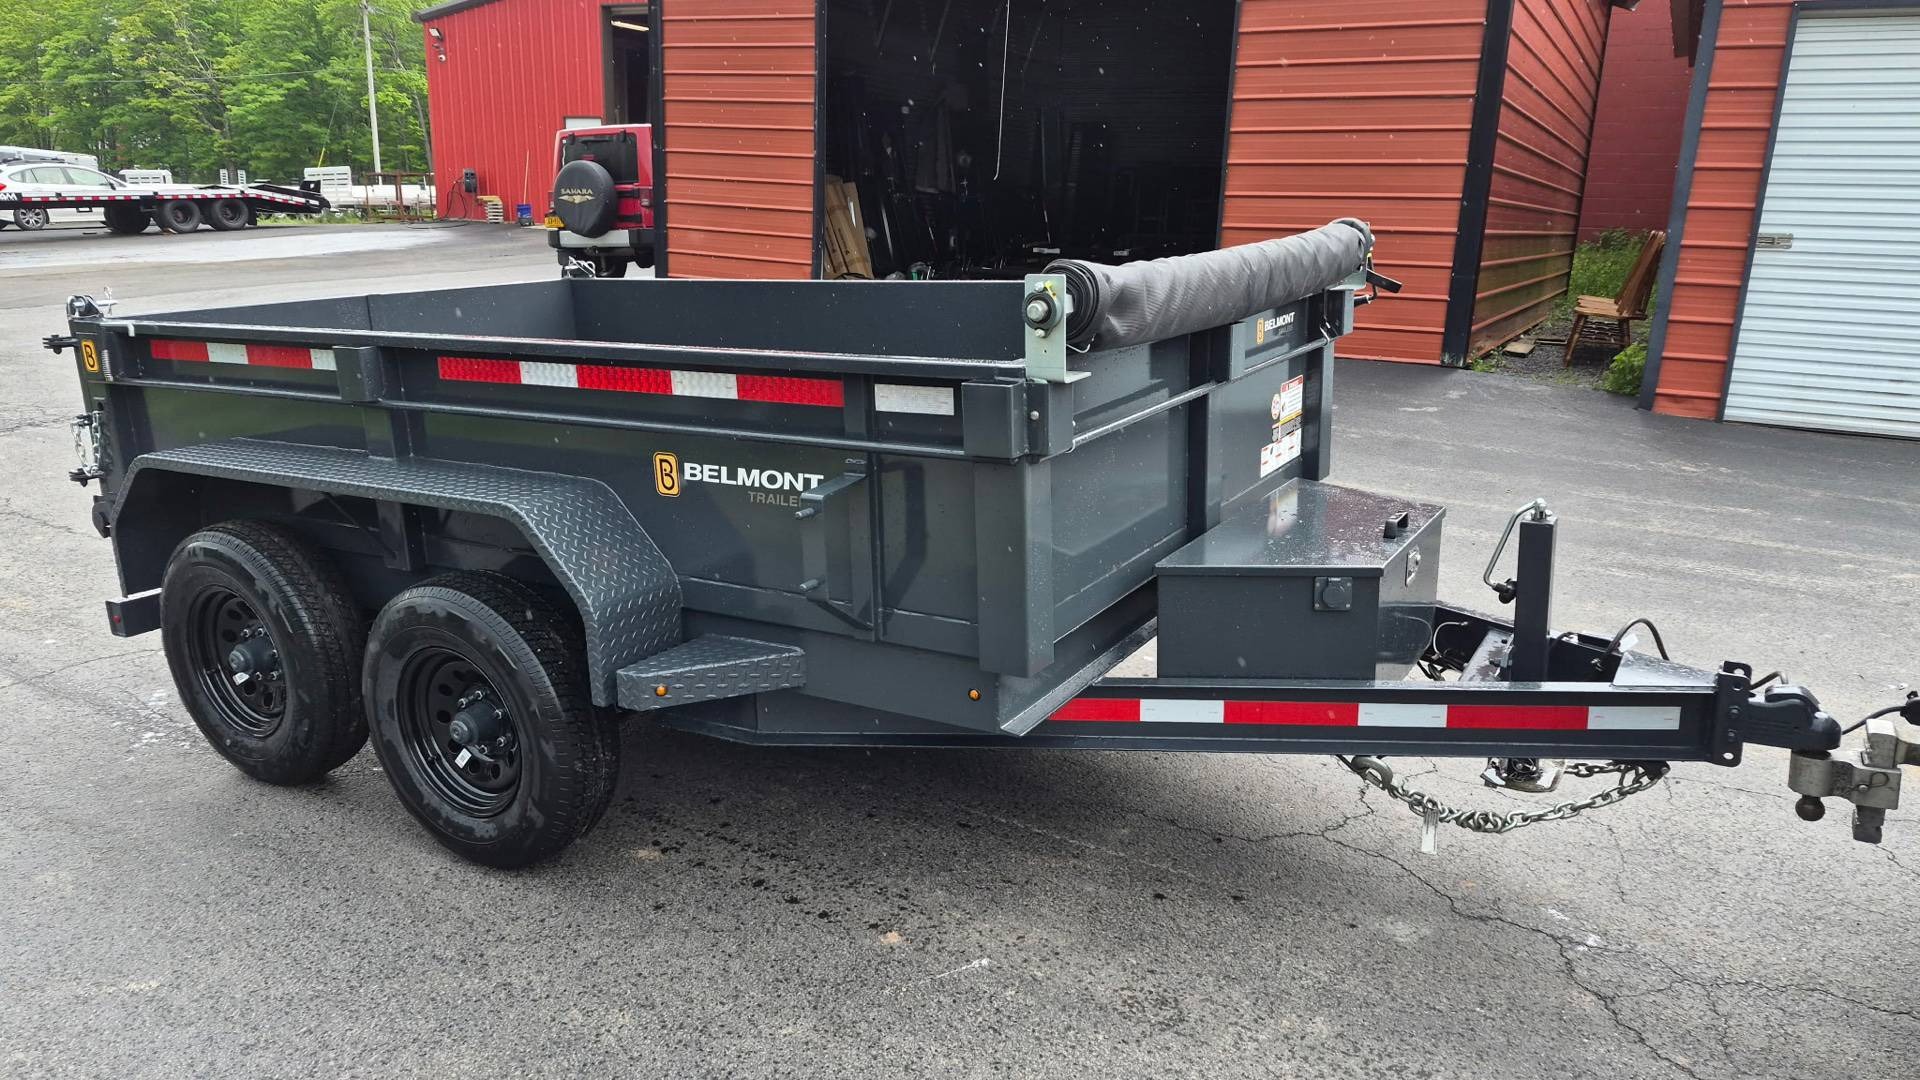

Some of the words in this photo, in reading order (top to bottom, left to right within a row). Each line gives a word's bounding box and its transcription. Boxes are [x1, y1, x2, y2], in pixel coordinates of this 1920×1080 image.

[1265, 311, 1296, 332] BELMONT
[683, 462, 824, 492] BELMONT
[748, 491, 801, 508] TRAILE
